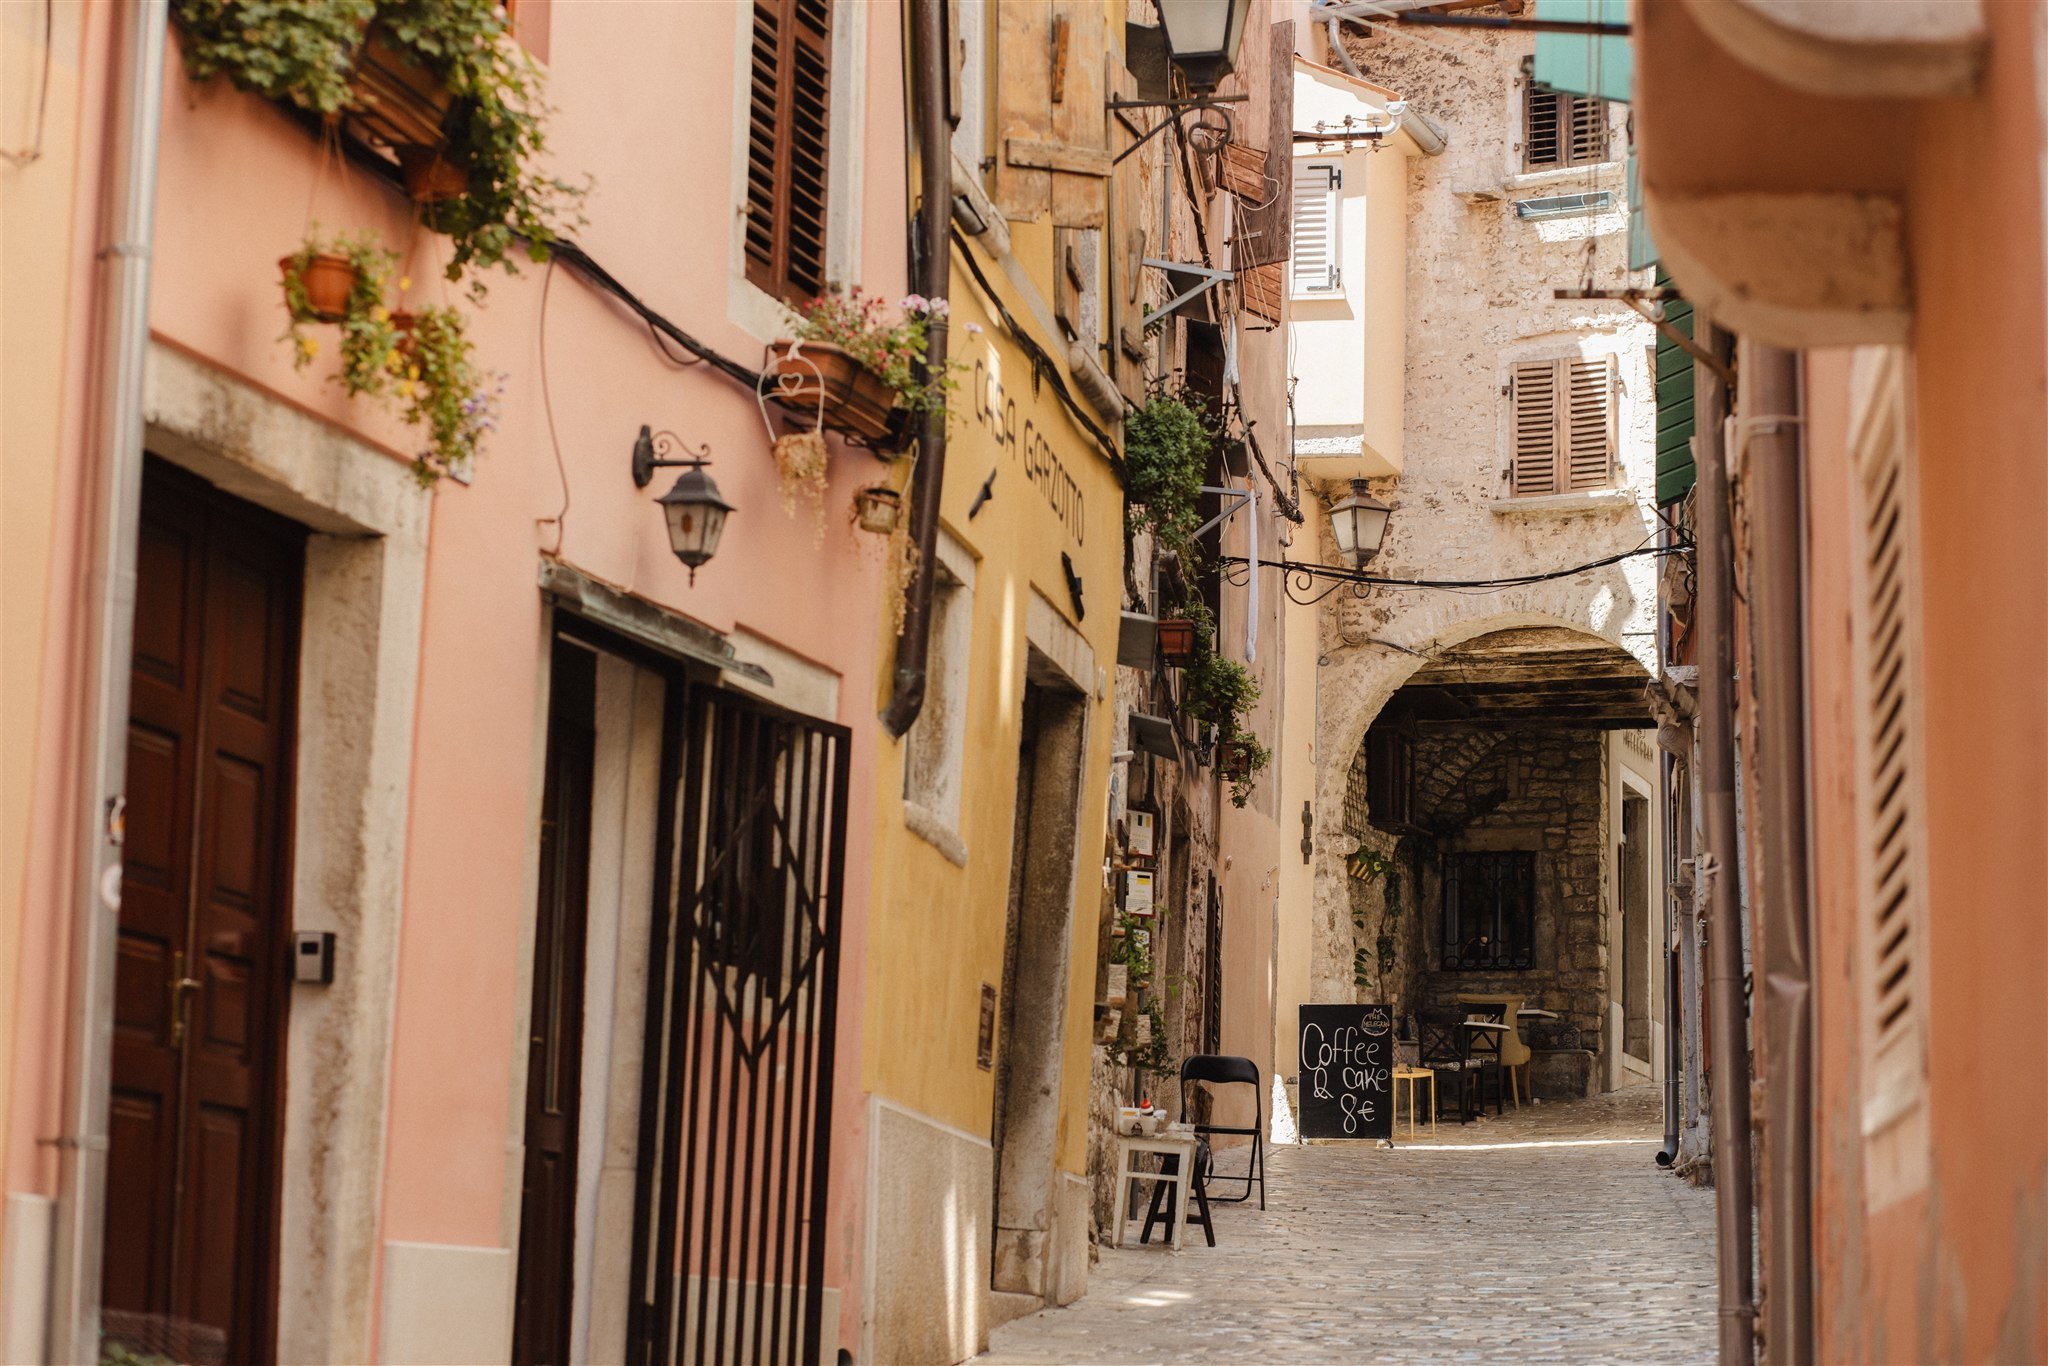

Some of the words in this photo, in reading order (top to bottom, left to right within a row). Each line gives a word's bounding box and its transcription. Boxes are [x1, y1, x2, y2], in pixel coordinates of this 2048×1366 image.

[975, 358, 1015, 460] CASA
[1023, 418, 1084, 547] GARZOTTO
[1302, 1022, 1380, 1071] Coffee
